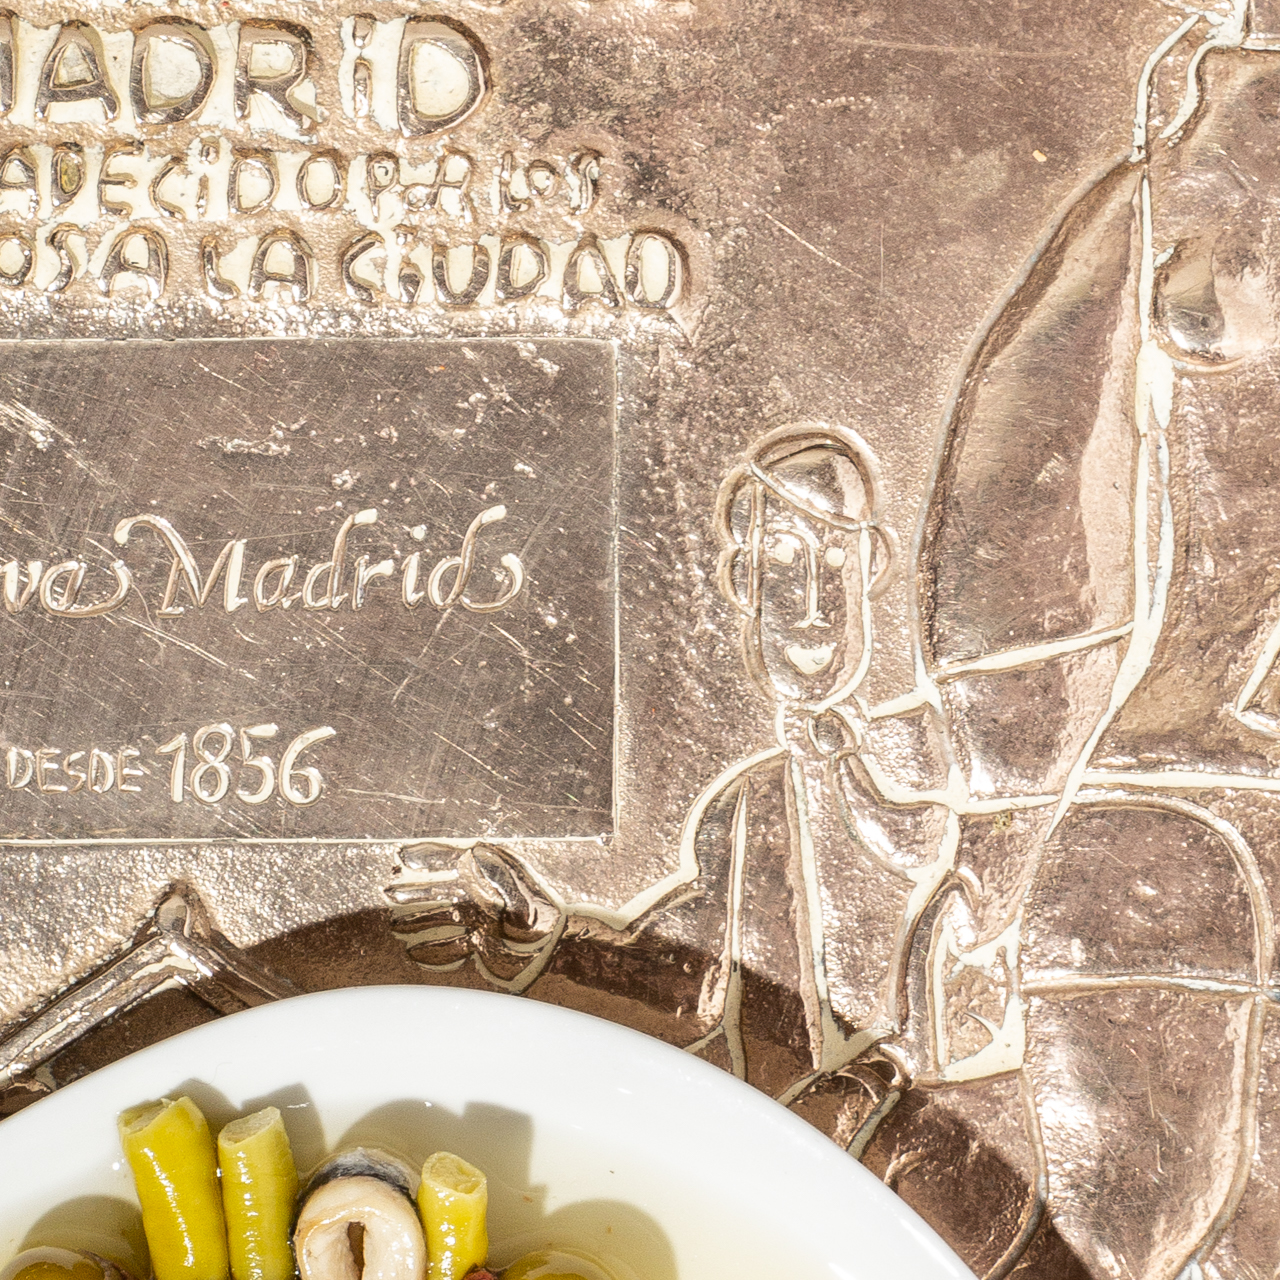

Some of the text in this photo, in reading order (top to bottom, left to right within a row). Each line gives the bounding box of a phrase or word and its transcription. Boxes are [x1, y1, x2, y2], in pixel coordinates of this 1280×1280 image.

[202, 226, 314, 304] LA
[340, 223, 692, 310] CIUDAD
[114, 506, 526, 618] Madrid
[6, 722, 337, 806] DESDE 1856
